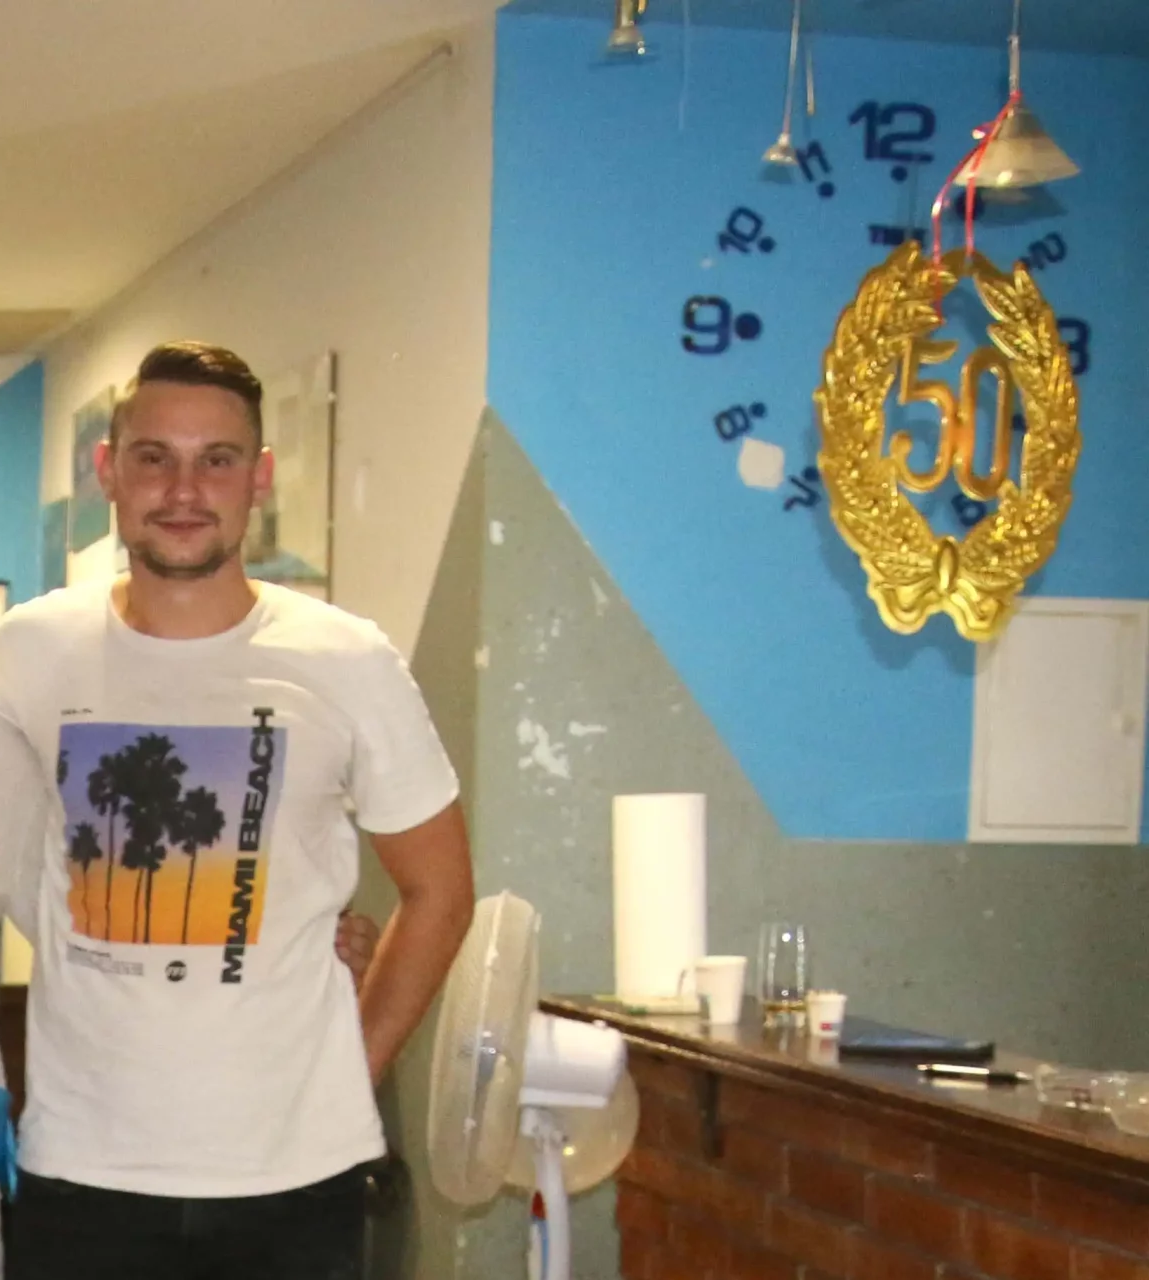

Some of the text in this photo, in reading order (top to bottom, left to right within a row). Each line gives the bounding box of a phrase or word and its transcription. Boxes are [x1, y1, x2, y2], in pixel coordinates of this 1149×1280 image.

[848, 101, 935, 161] 12
[717, 206, 763, 254] 10
[682, 295, 732, 355] 9
[714, 405, 752, 442] 8
[888, 336, 1012, 502] 50
[220, 706, 275, 984] MIAMI BEACH
